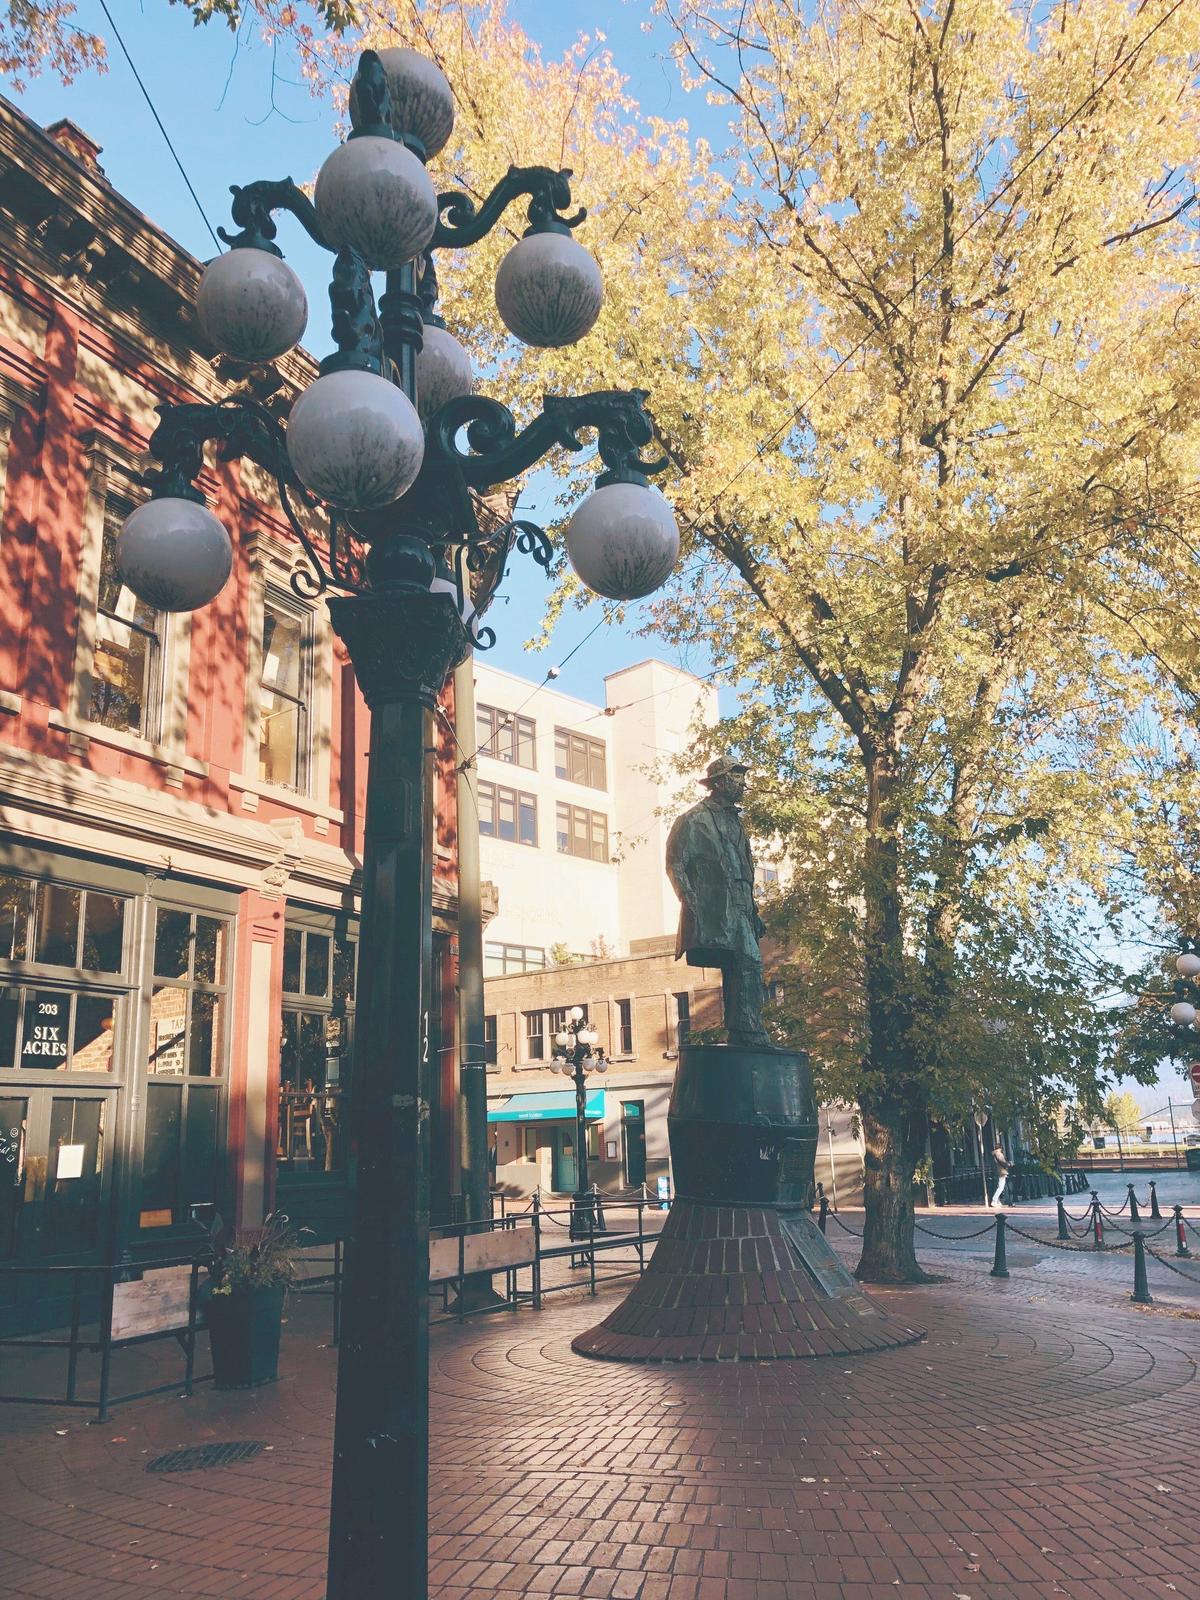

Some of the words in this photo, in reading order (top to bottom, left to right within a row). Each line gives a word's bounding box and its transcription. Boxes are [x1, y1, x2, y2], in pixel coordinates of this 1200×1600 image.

[38, 1003, 58, 1015] 203
[34, 1026, 59, 1041] SIX
[22, 1041, 67, 1056] ACRES
